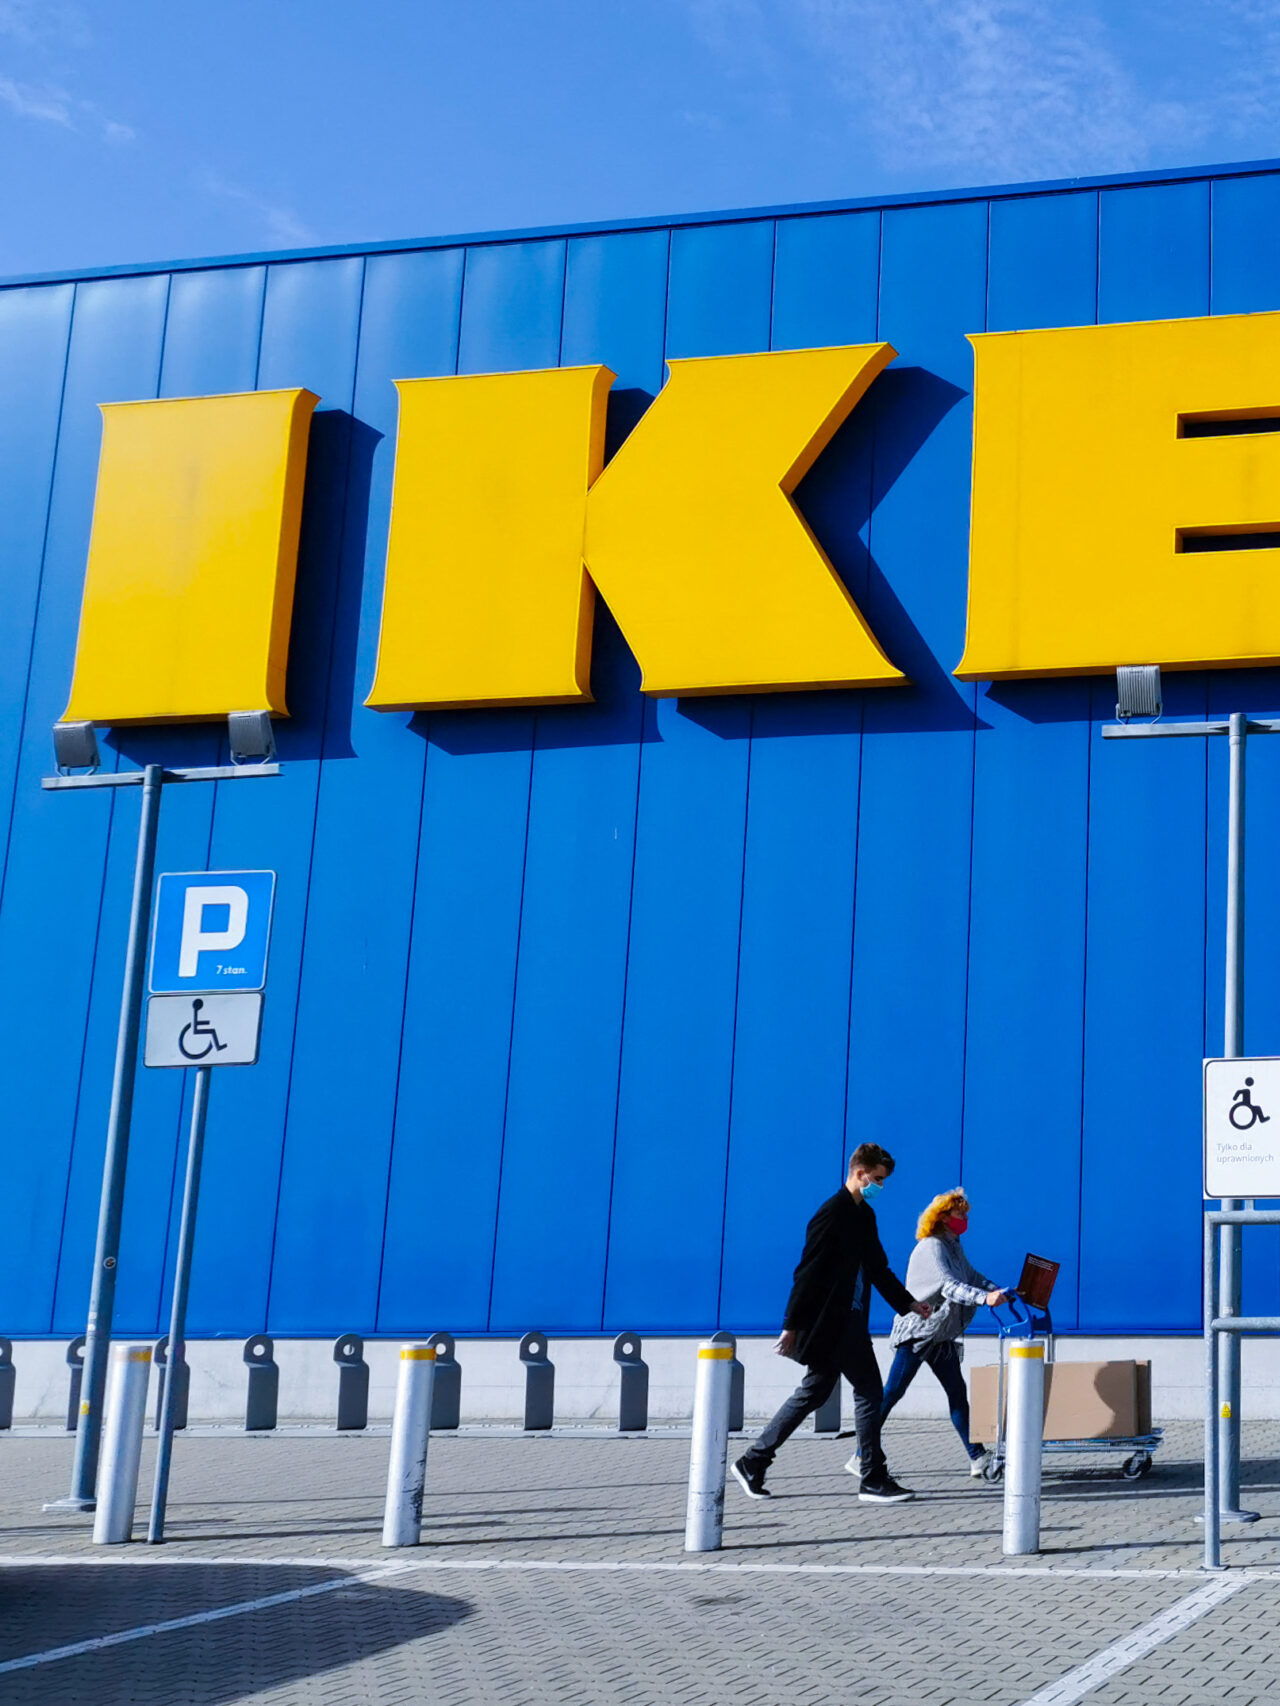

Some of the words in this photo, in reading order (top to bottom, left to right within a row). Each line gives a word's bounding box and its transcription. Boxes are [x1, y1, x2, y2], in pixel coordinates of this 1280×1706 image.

[178, 885, 249, 978] P
[216, 964, 223, 975] 7
[223, 965, 248, 975] stan.
[1216, 1143, 1238, 1152] Tylko
[1239, 1142, 1253, 1151] dla
[1216, 1154, 1274, 1164] uprawnionych
